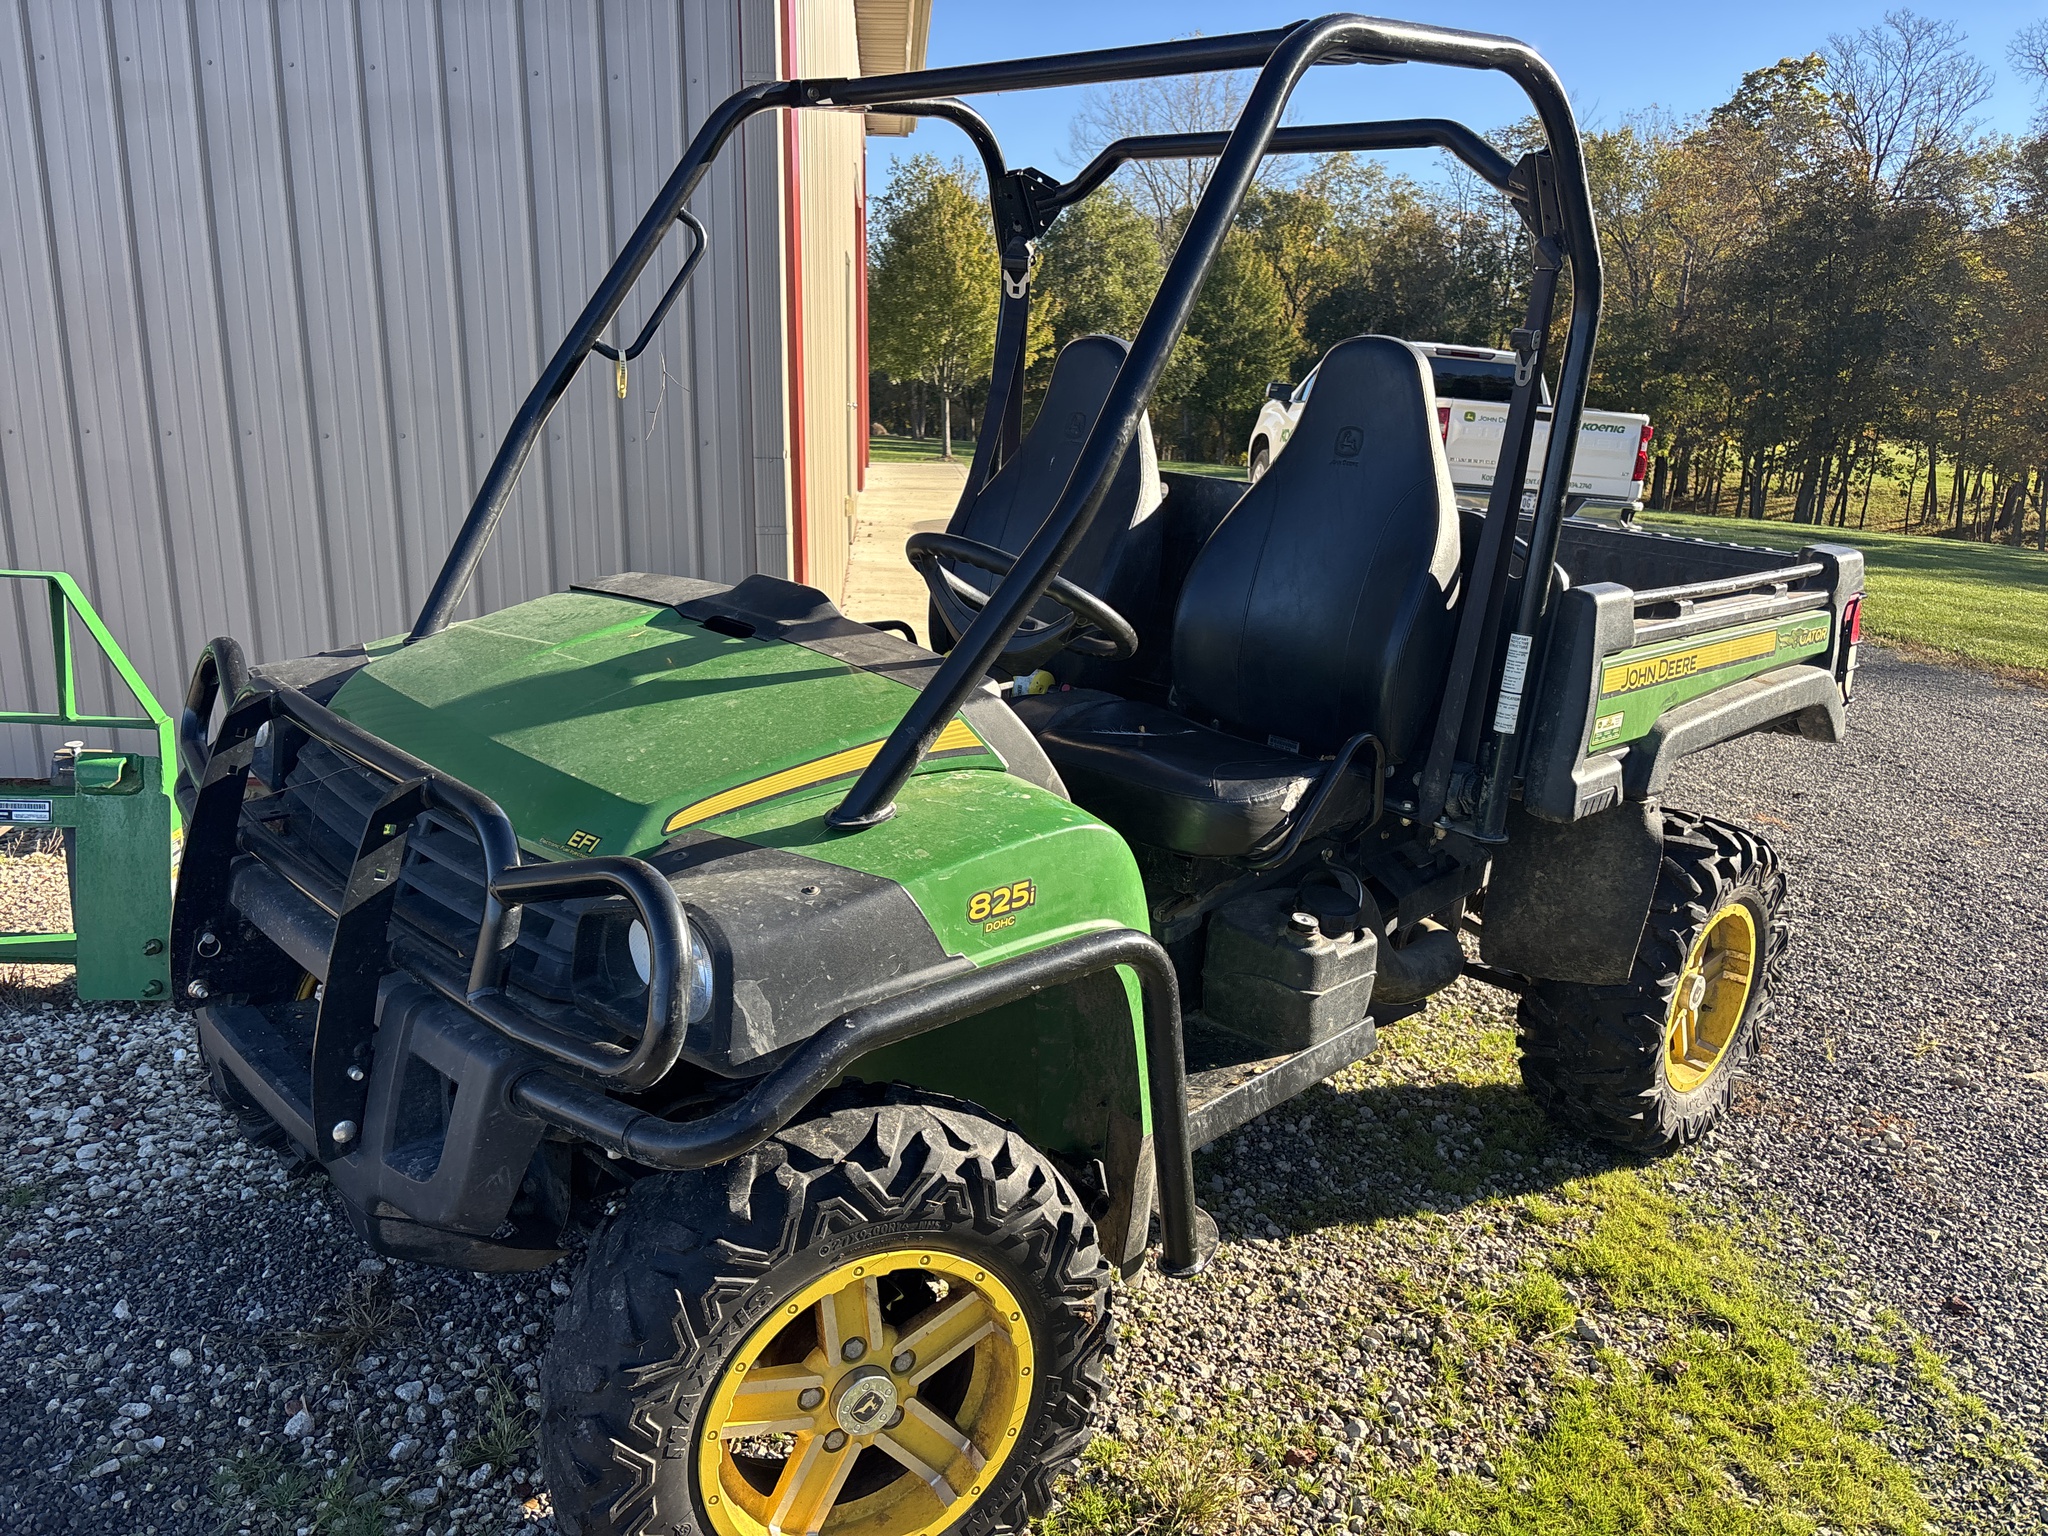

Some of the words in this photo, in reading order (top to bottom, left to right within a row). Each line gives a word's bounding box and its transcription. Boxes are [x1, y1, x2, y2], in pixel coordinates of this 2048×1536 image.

[1799, 627, 1828, 647] GATOR
[1621, 664, 1657, 690] JOHN
[1658, 655, 1698, 680] DEERE
[566, 829, 602, 854] EFI
[967, 878, 1037, 923] 825i
[985, 915, 1016, 933] DOHC
[661, 1285, 775, 1460] MAXXIS
